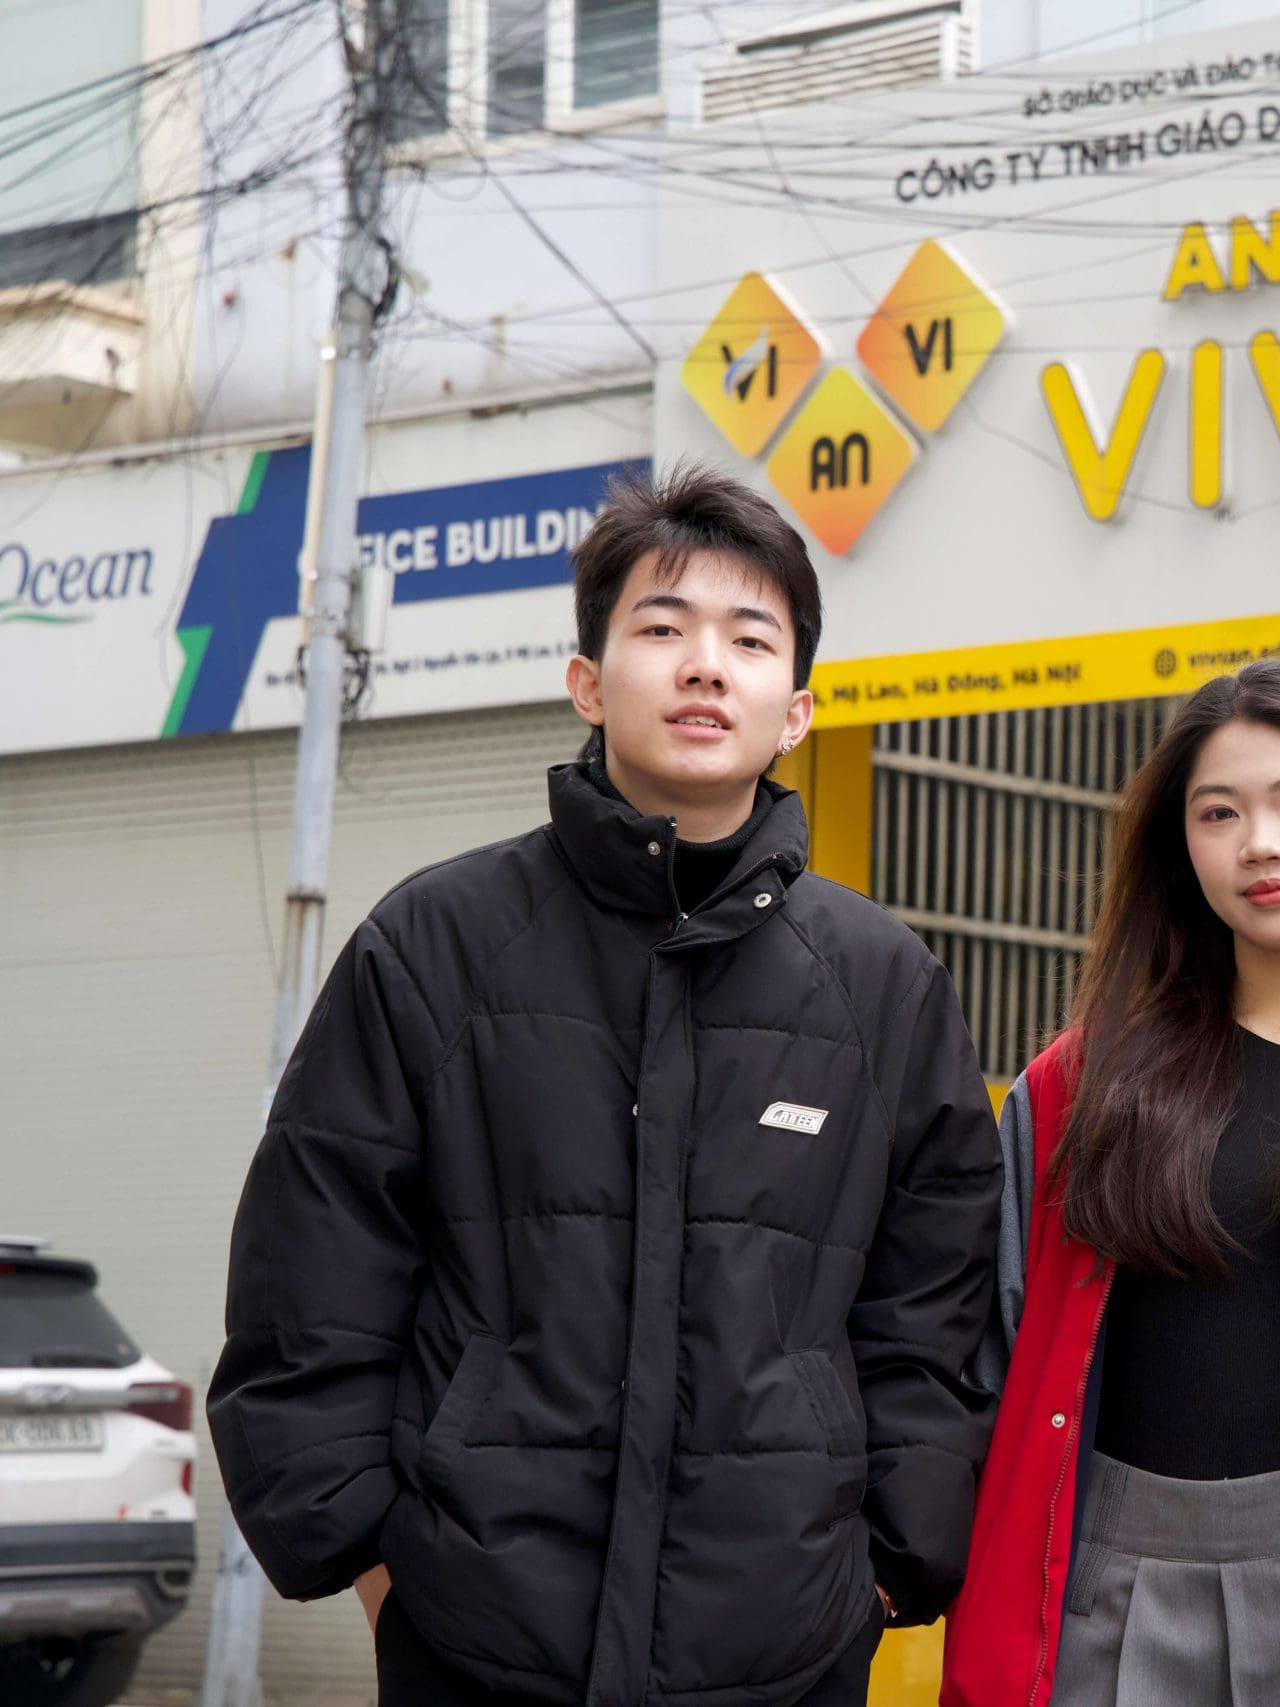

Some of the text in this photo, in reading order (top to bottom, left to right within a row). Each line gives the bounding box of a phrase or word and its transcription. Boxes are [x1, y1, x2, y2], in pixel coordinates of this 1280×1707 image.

[1059, 80, 1116, 113] GIÁO
[1120, 69, 1167, 103] DỤC
[1172, 60, 1199, 89] VÀ
[1205, 53, 1256, 86] ĐÀO
[895, 158, 996, 203] CÔNG
[1006, 144, 1048, 185] TY
[1059, 130, 1146, 176] TNHH
[1155, 108, 1246, 156] GIÁO
[905, 317, 954, 377] VI
[0, 541, 154, 607] Ocean
[1012, 664, 1039, 685] Hà
